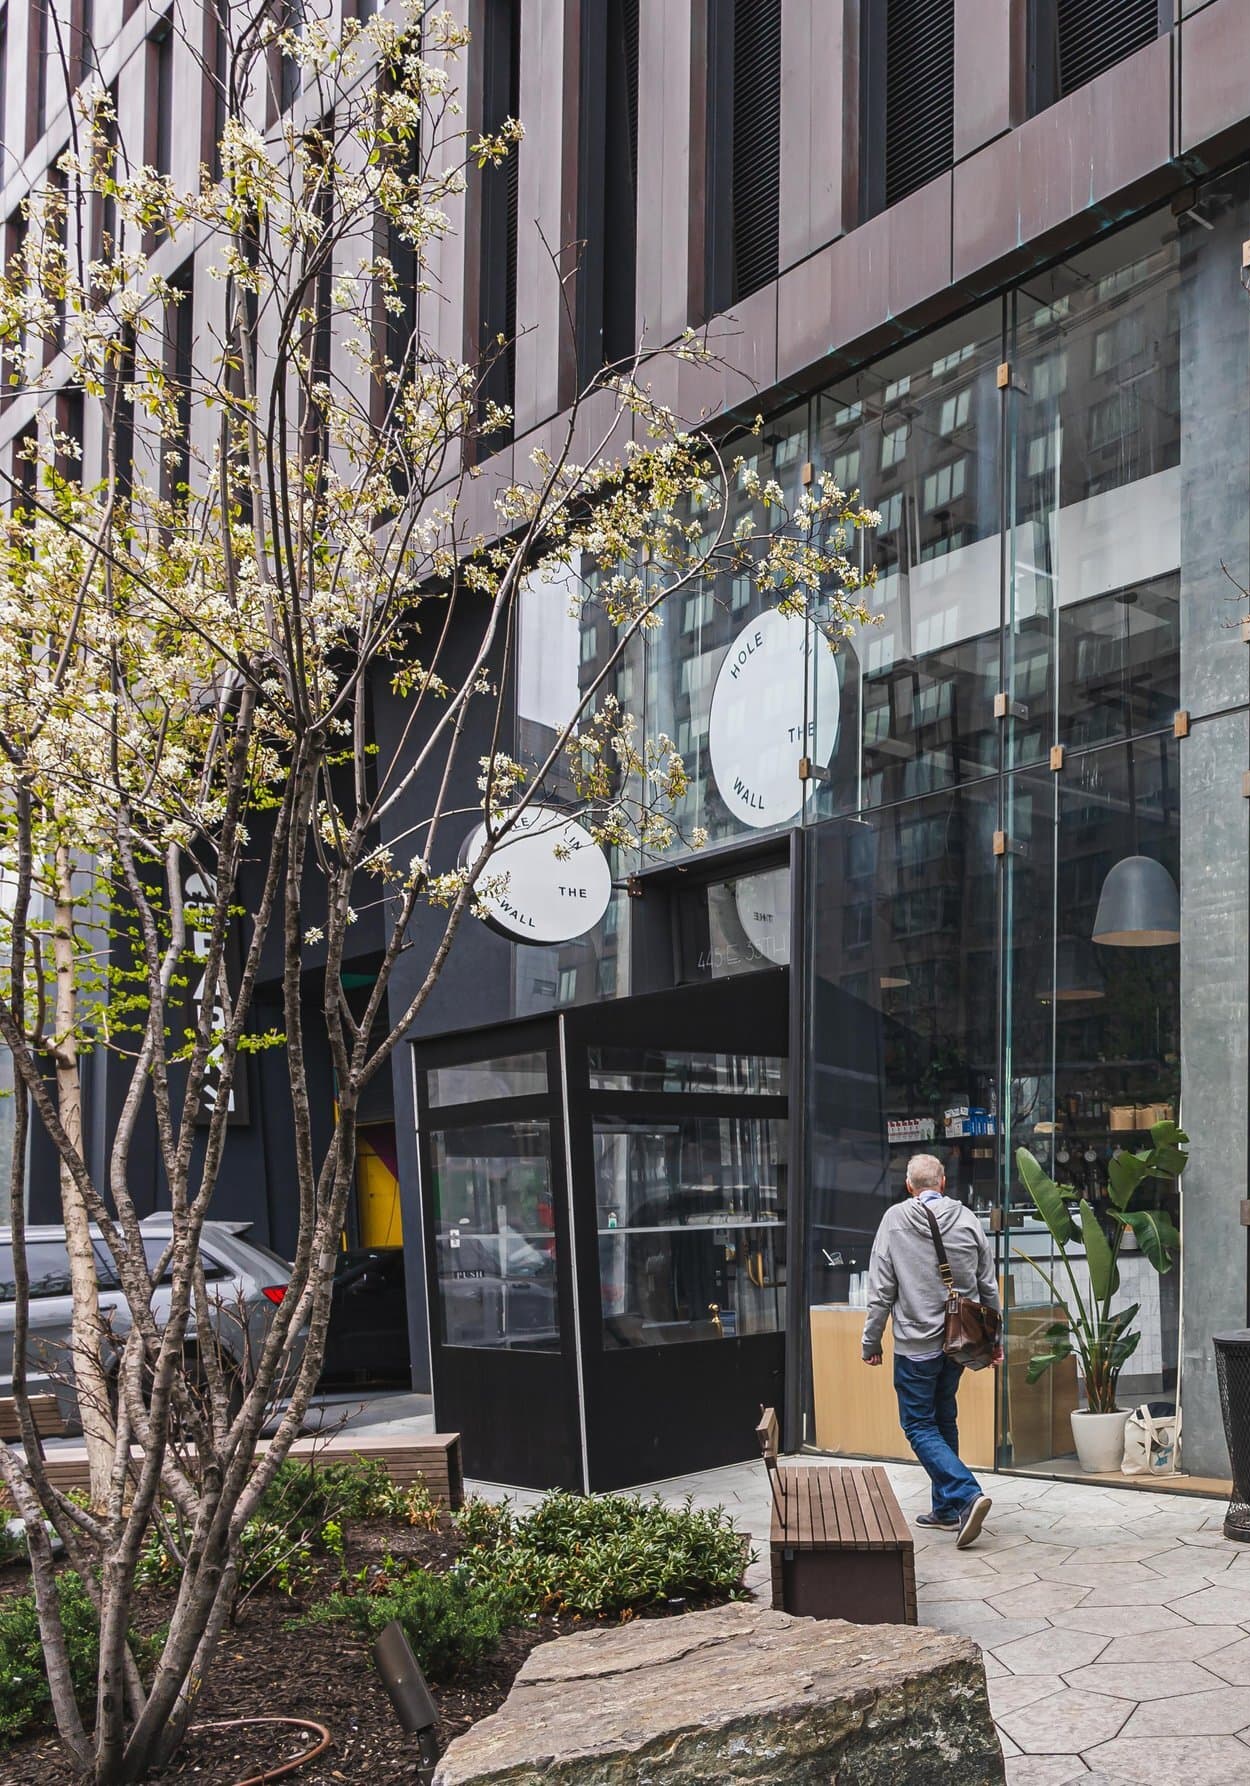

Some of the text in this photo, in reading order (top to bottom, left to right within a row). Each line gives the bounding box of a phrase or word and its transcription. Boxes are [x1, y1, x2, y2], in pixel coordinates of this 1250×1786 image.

[729, 631, 764, 680] HOLE
[787, 720, 815, 744] THE
[732, 776, 766, 811] WALL
[558, 885, 588, 899] THE
[498, 898, 537, 928] WALL
[456, 1271, 483, 1281] PUSH
